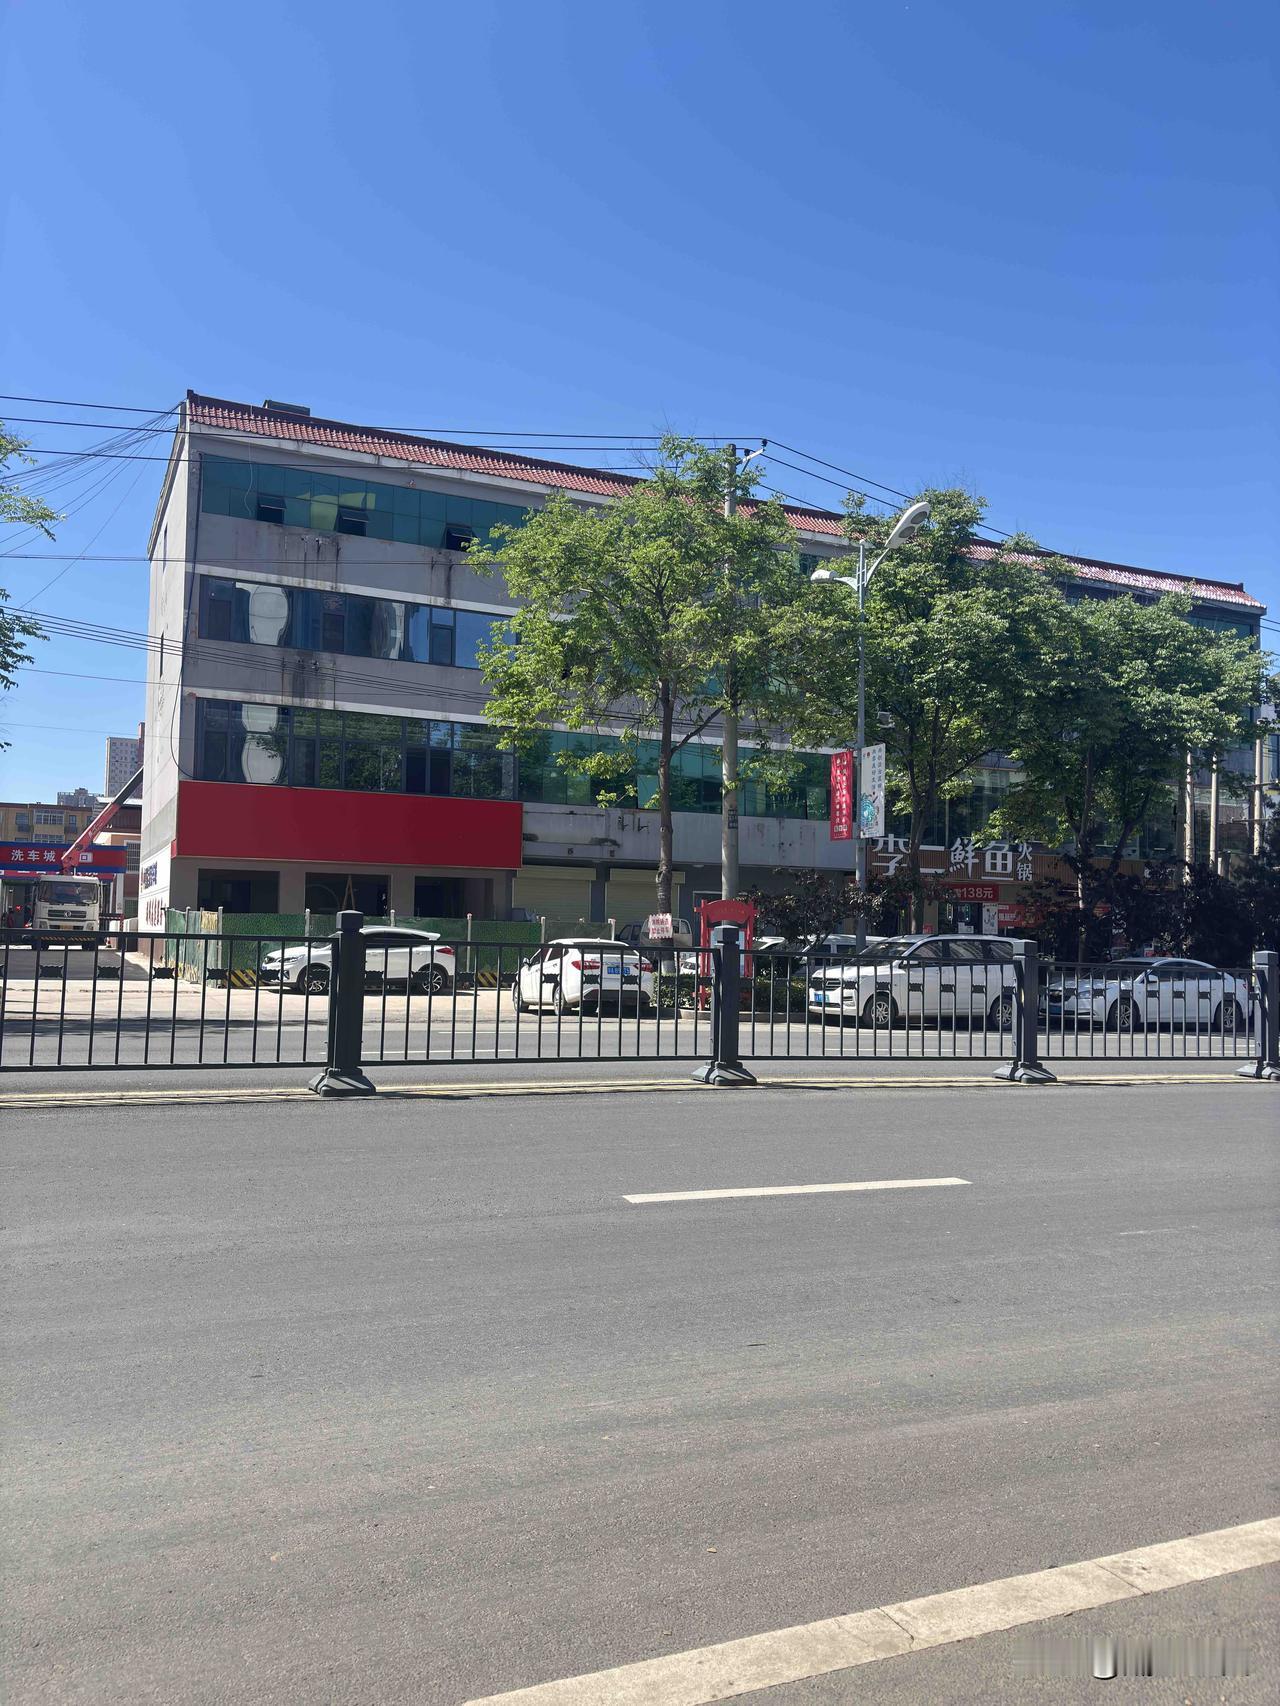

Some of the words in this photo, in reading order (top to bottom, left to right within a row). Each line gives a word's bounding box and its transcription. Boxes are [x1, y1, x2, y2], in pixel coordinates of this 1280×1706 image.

[11, 849, 56, 862] 洗车城
[1017, 843, 1033, 881] 火锅
